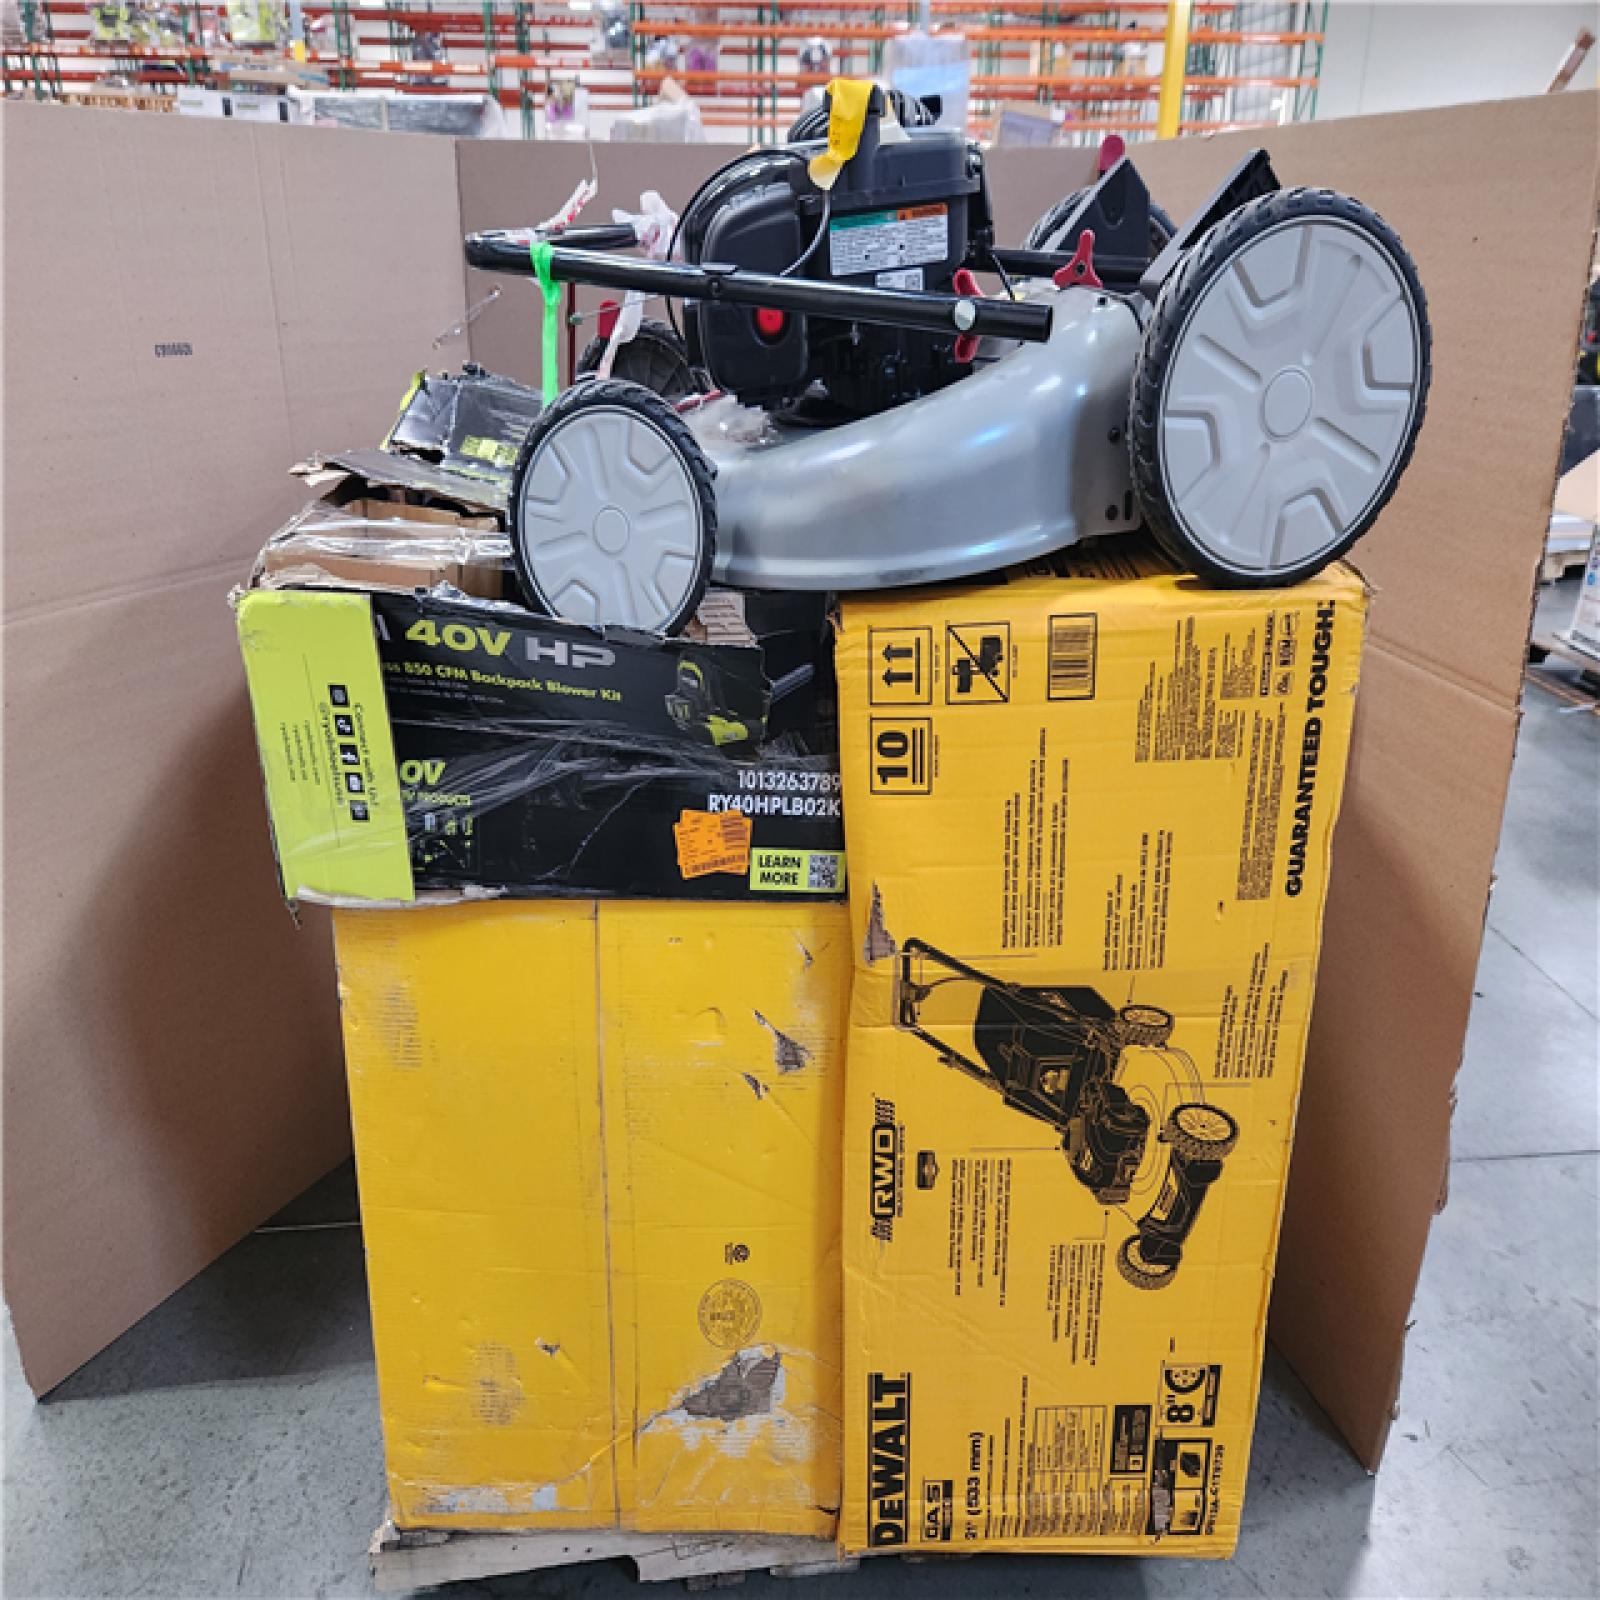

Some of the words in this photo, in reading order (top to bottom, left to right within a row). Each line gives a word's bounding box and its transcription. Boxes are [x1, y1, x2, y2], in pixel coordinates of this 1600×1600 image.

[405, 619, 512, 657] 40V
[525, 636, 616, 669] HP
[876, 731, 909, 786] 10
[1284, 716, 1322, 897] GUARANTEED
[758, 854, 801, 869] LEARN
[759, 871, 799, 886] MORE
[874, 1128, 895, 1215] RWD
[873, 1372, 906, 1546] DEWALT
